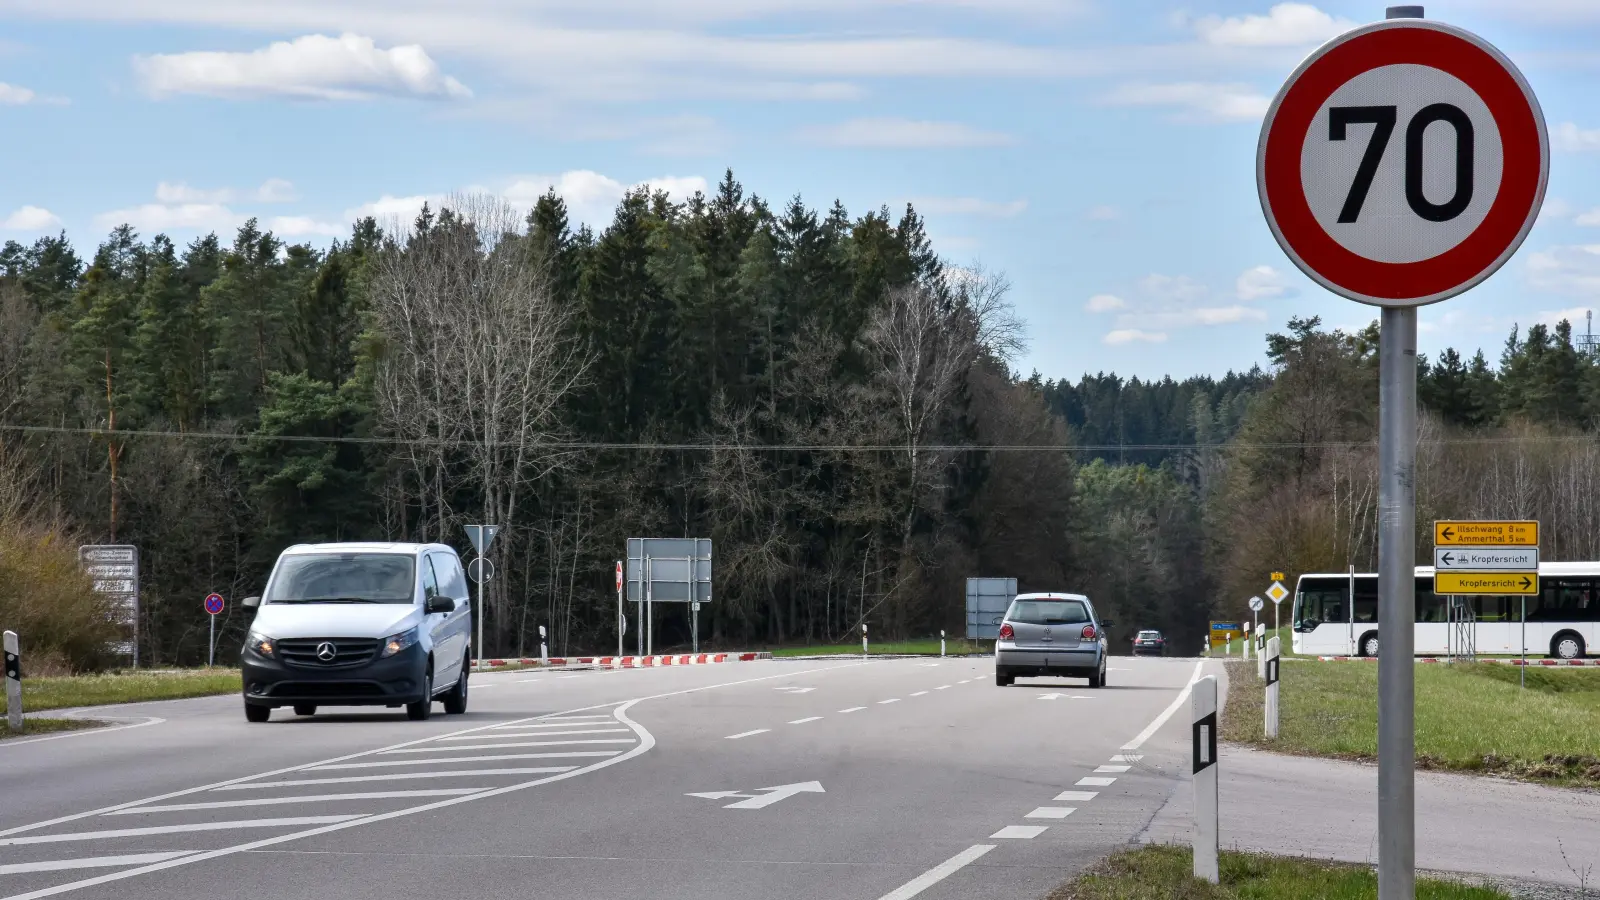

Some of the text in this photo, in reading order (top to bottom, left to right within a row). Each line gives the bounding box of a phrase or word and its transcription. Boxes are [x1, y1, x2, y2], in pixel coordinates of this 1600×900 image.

[1329, 103, 1474, 223] 70
[1457, 525, 1503, 534] Illschwang
[1508, 525, 1514, 533] 8
[1457, 535, 1505, 543] Ammerthal
[1508, 535, 1514, 543] 5
[1471, 555, 1528, 564] Kropfersricht
[1459, 579, 1516, 588] Kropfersricht
